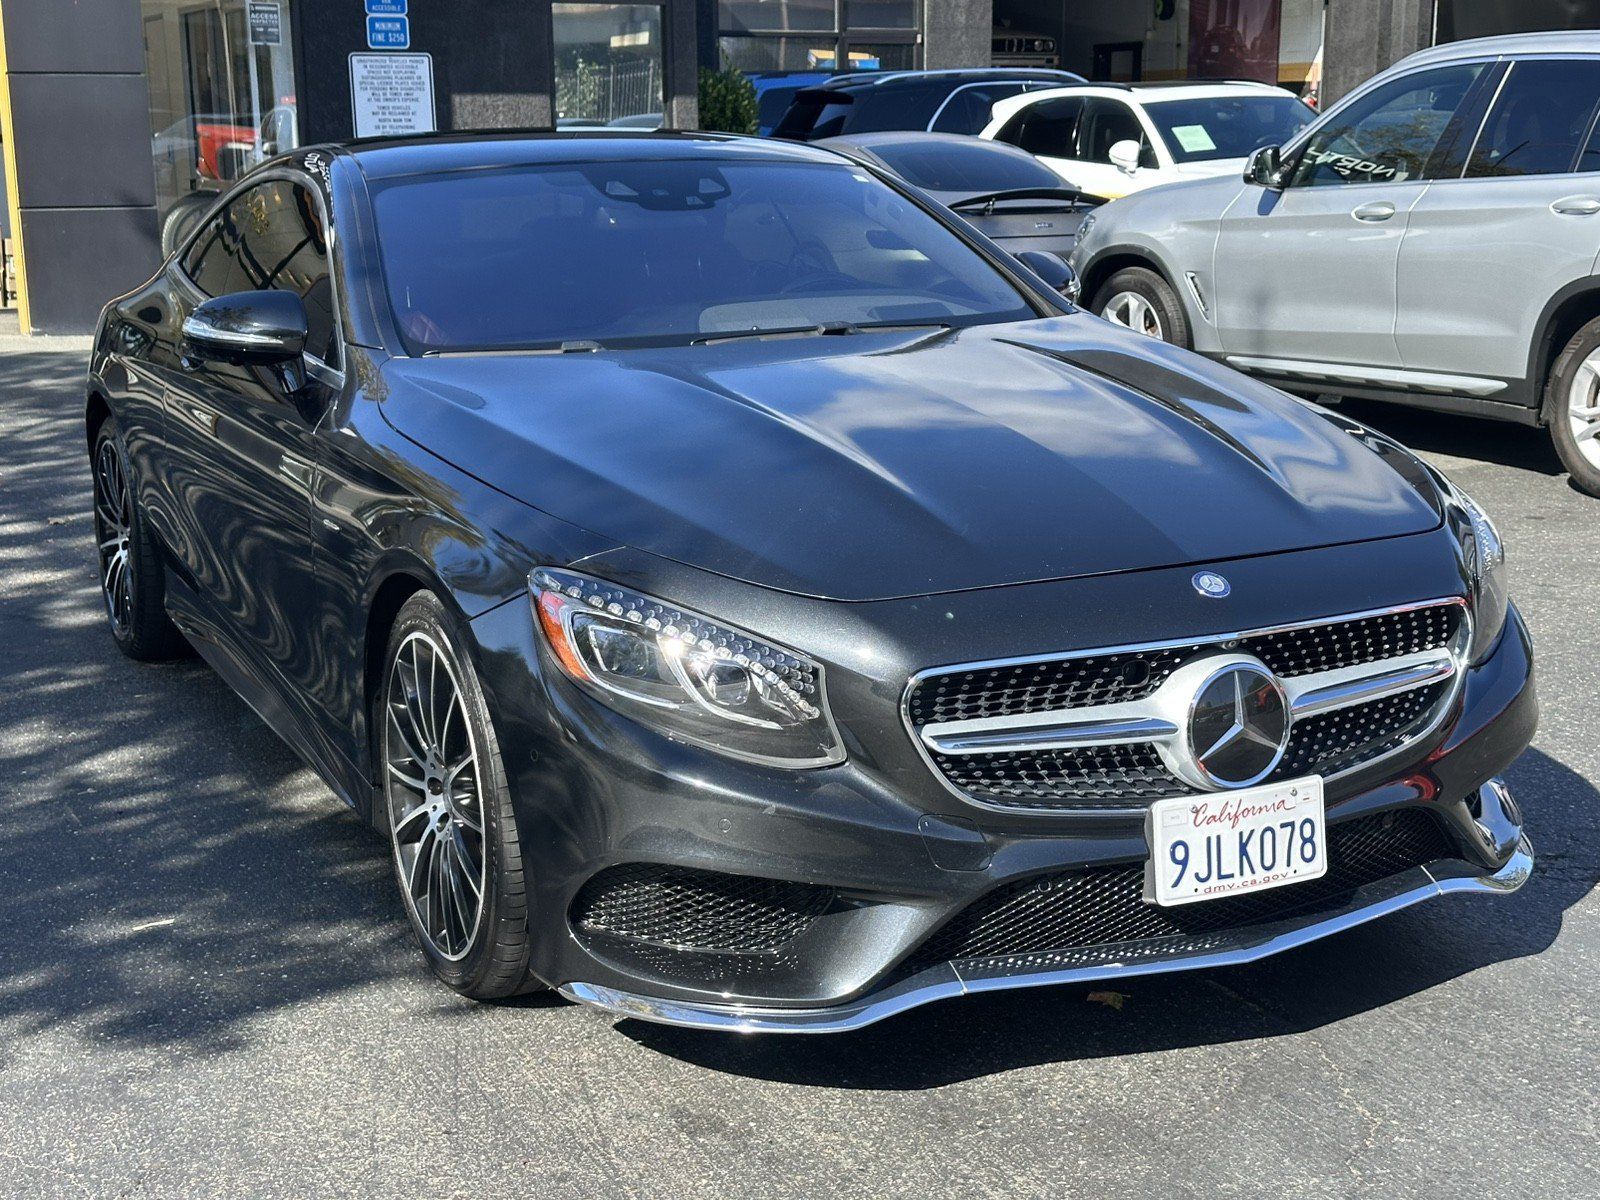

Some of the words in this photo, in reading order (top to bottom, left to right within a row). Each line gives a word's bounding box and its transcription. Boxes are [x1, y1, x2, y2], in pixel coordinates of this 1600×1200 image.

[374, 22, 401, 30] MINIMUM
[372, 33, 385, 42] FINE
[388, 33, 404, 42] $250
[1193, 794, 1296, 829] California
[1170, 818, 1316, 888] 9JLK078
[1204, 872, 1289, 894] dmv.ca.gov
